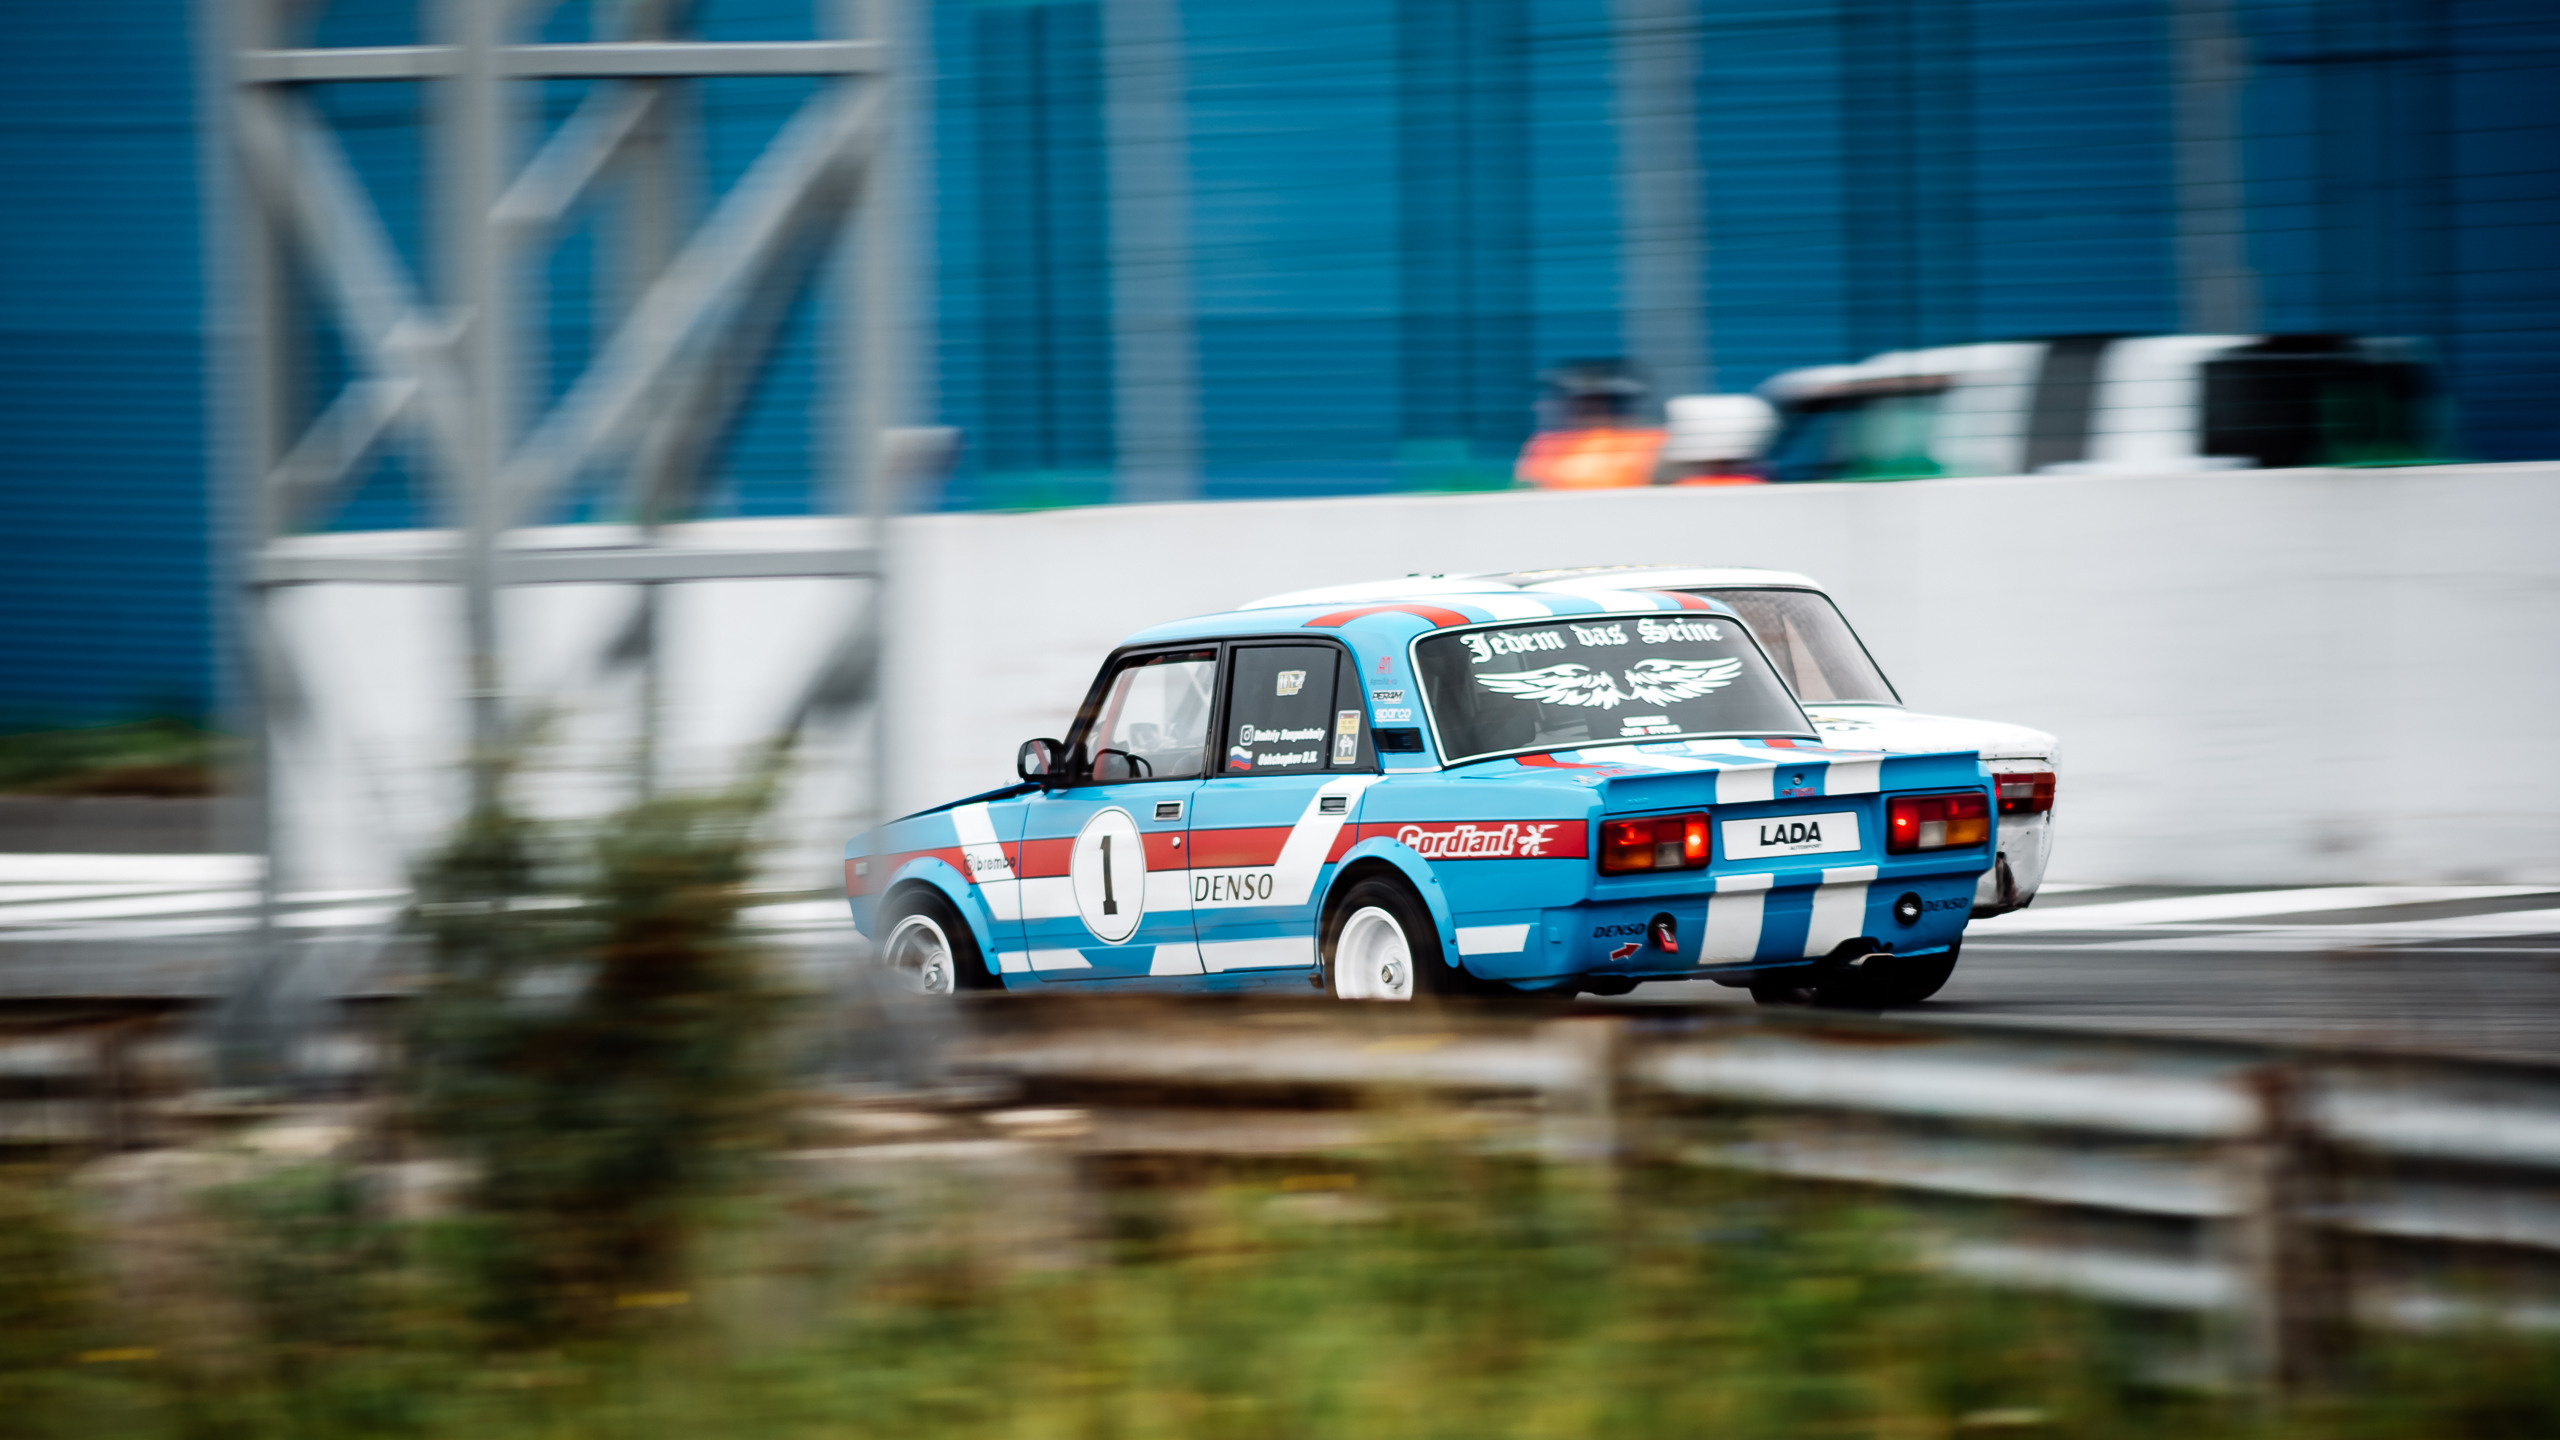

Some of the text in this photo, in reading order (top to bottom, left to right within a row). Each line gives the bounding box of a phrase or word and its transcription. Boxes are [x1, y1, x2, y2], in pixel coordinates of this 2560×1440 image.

[1460, 617, 1724, 664] Jedem das Seine
[1375, 708, 1412, 720] sparco
[1397, 824, 1518, 857] Cordiant
[1760, 821, 1822, 846] LADA
[976, 855, 1016, 872] brembo
[1099, 835, 1118, 916] 1
[1195, 873, 1274, 902] DENSO
[1922, 896, 1969, 913] DENSO
[1592, 922, 1646, 938] DENSO
